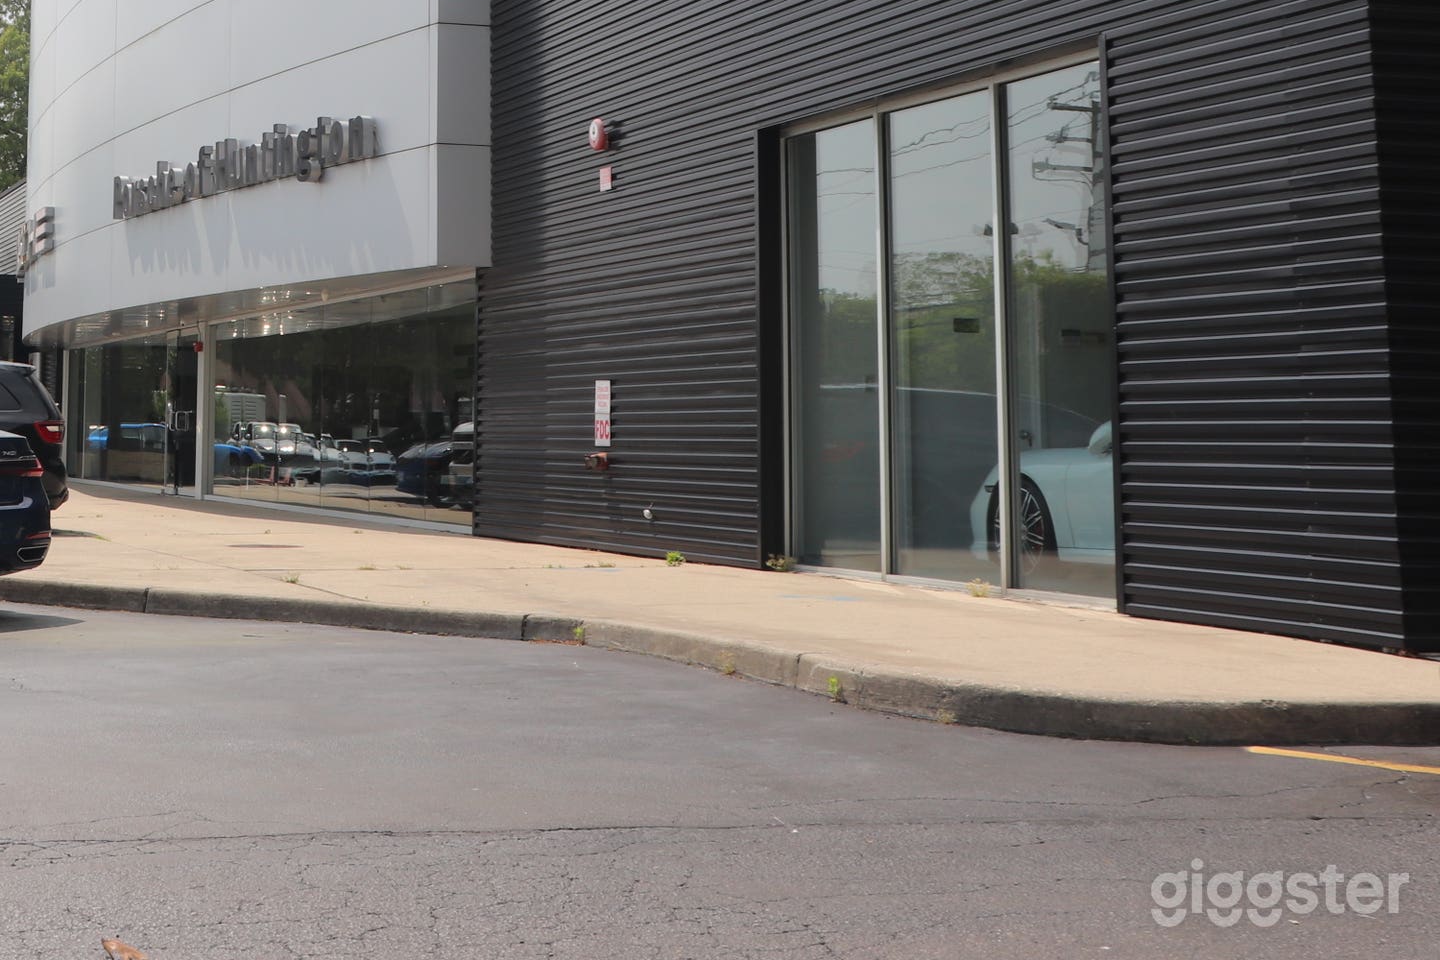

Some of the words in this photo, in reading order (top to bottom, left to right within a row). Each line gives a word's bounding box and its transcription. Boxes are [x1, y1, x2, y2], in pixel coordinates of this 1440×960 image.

[183, 145, 217, 201] of
[215, 115, 377, 183] Huntington
[595, 420, 610, 440] FDC
